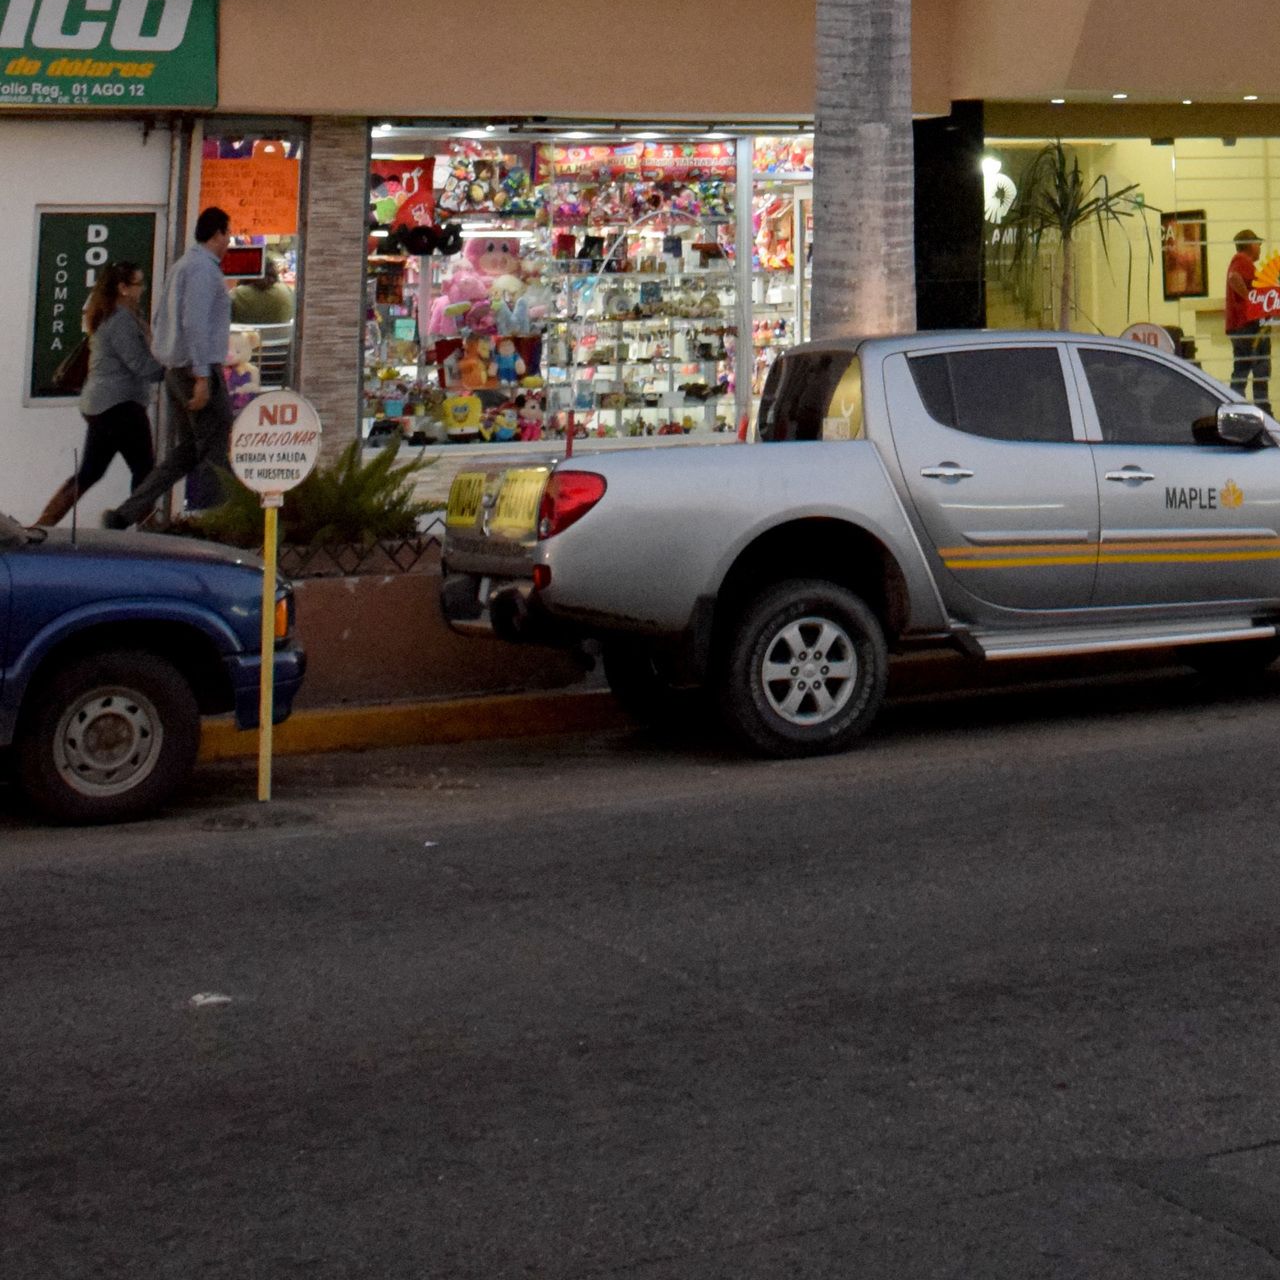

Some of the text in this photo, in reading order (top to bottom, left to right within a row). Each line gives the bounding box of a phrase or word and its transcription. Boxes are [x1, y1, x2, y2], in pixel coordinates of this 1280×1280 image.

[0, 82, 28, 95] olio
[72, 83, 87, 95] 01
[92, 84, 124, 96] AGO
[129, 84, 144, 96] 12
[51, 253, 68, 350] COMPRA
[258, 404, 298, 426] NO
[235, 431, 317, 448] ESTACIONAR
[235, 452, 266, 463] ENTRADA
[277, 452, 306, 462] SALIDA
[244, 468, 254, 479] DE
[1165, 486, 1217, 509] MAPLE
